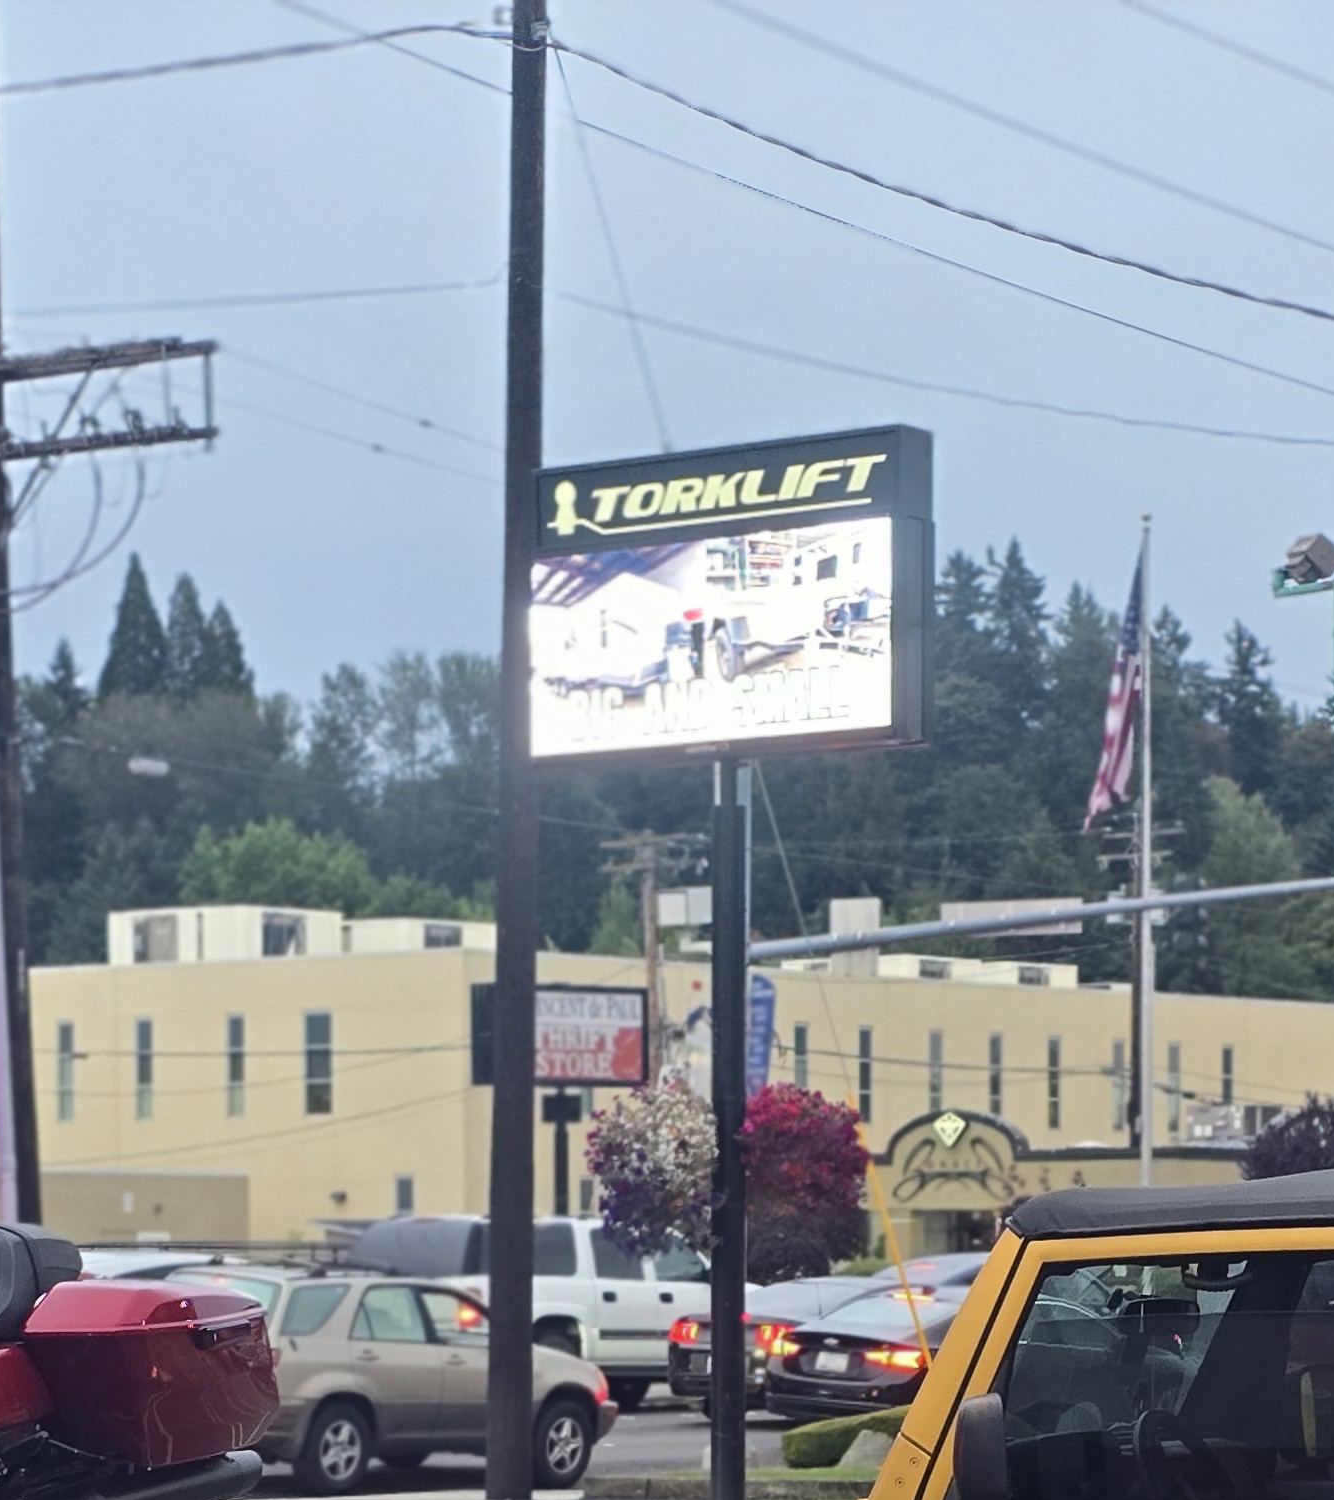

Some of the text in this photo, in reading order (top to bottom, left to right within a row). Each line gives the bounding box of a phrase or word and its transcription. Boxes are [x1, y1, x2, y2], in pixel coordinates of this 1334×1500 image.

[591, 454, 886, 523] TORKLIFT
[731, 665, 850, 728] SMALL
[534, 1024, 616, 1051] THRIFT
[534, 1050, 613, 1078] STORE
